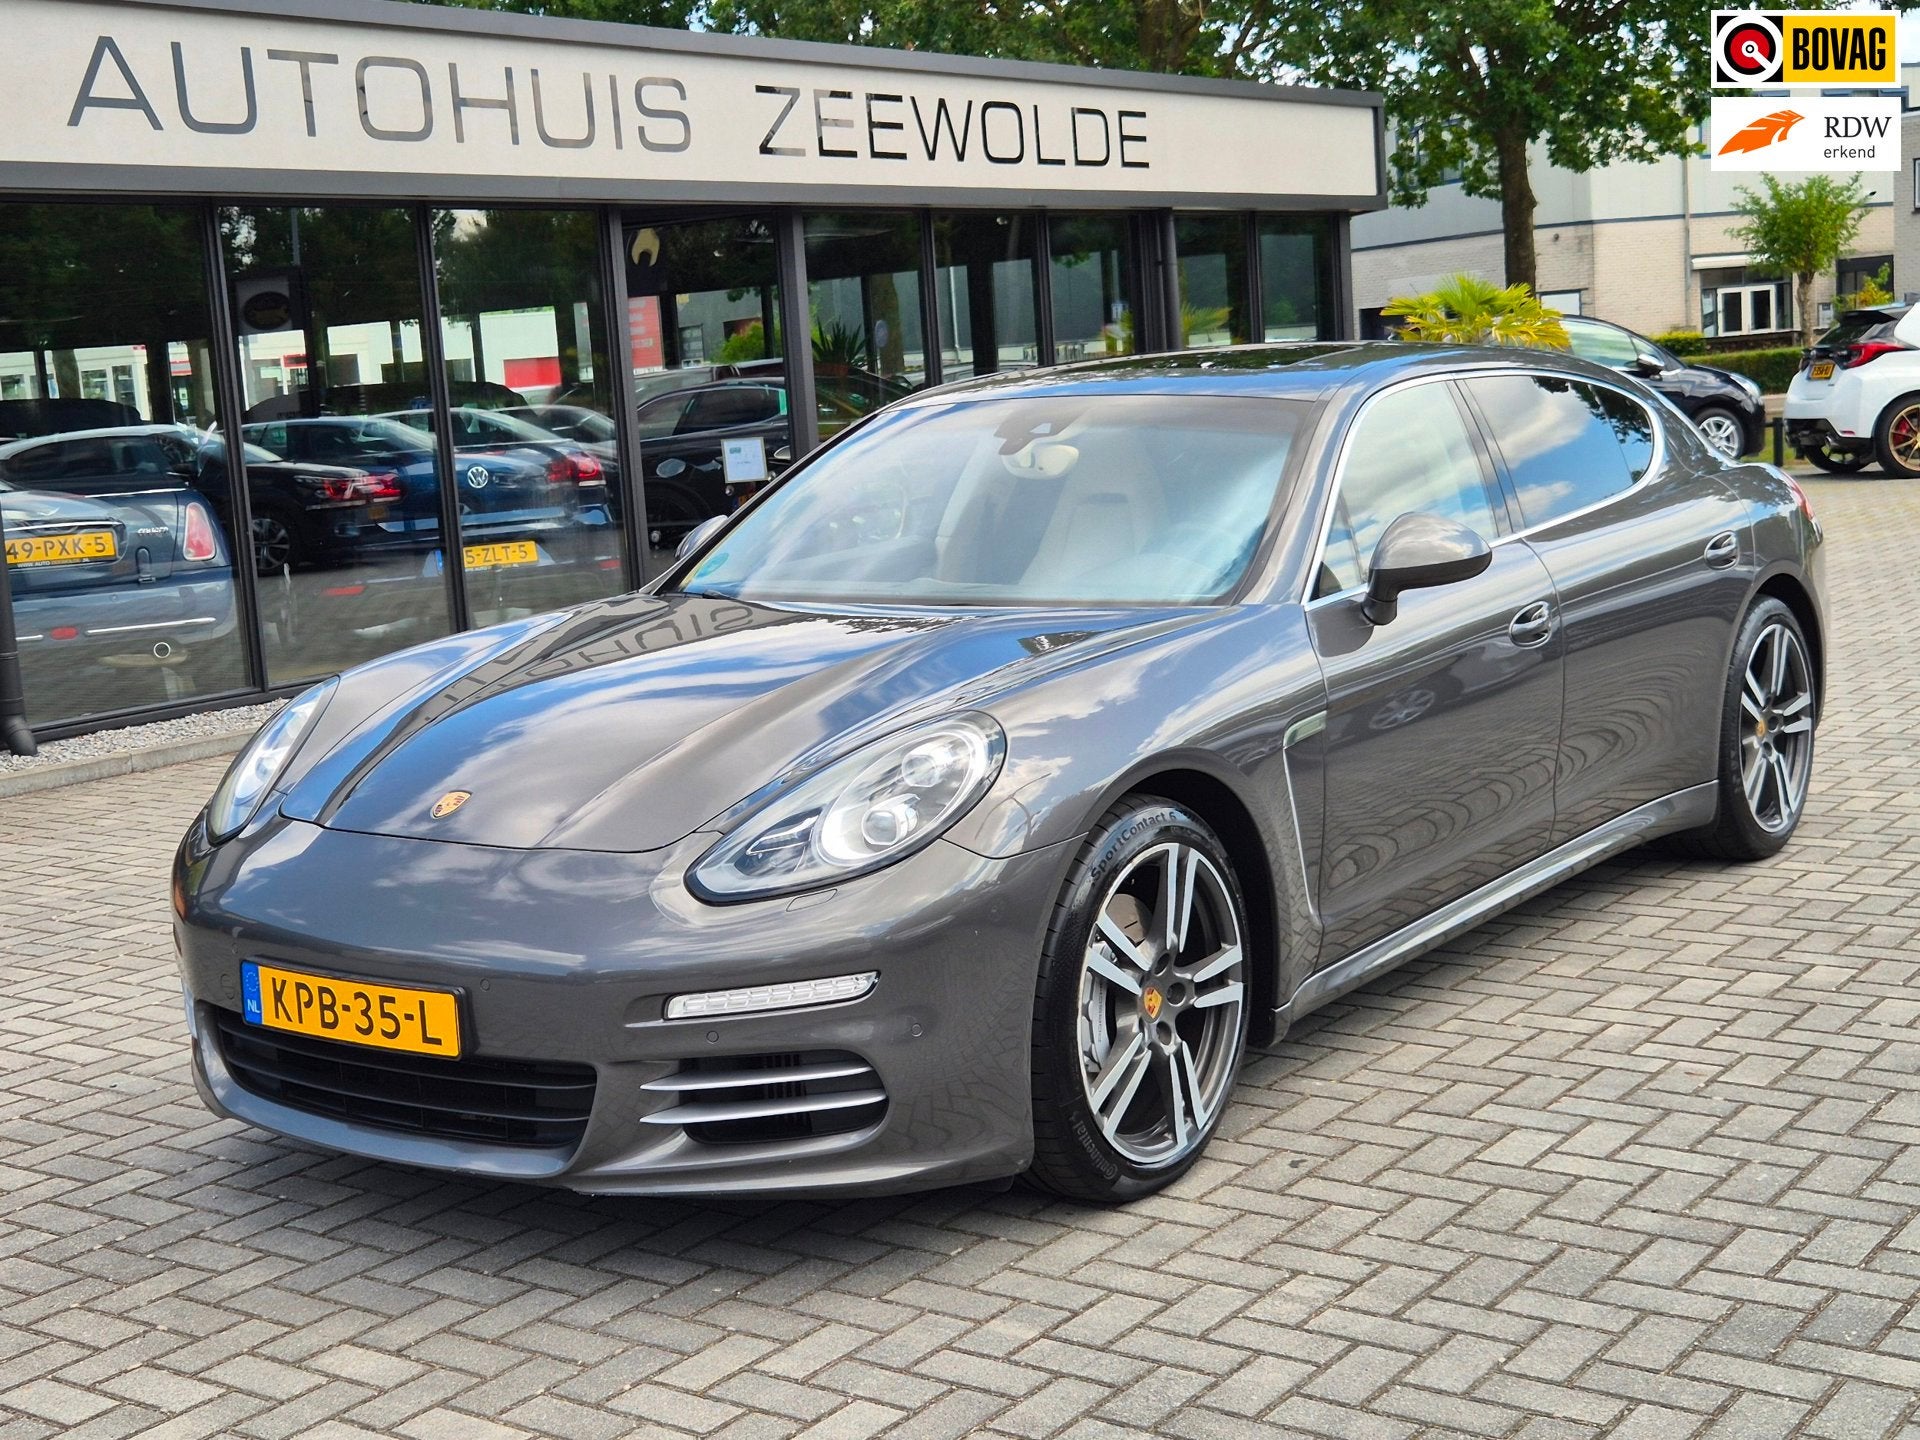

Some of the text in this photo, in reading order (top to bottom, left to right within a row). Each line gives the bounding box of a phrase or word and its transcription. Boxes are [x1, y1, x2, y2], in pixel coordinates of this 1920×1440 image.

[67, 35, 1150, 169] AUTOHUIS ZEEWOLDE
[6, 536, 107, 560] 49-PXK-5
[464, 544, 528, 565] 5-ZLT-5
[1090, 811, 1177, 880] SportContact 6
[247, 999, 260, 1014] NL
[271, 977, 443, 1046] KPB-35-L
